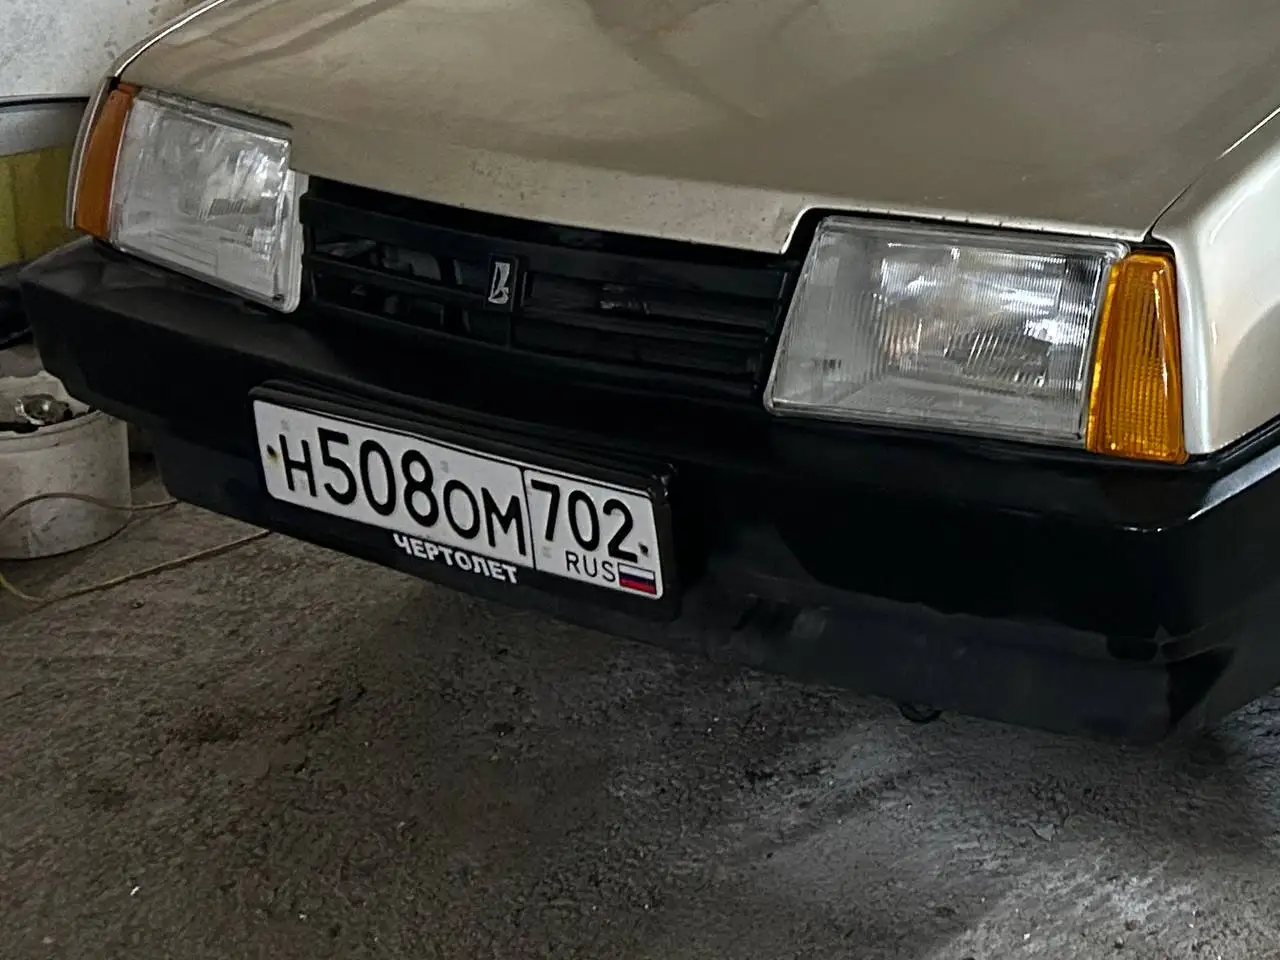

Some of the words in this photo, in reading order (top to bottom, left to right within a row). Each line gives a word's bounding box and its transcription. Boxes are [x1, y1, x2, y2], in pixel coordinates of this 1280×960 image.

[279, 427, 527, 556] Н508ОМ
[531, 479, 638, 562] 702
[394, 533, 518, 584] ЧЕРТОЛЕТ
[565, 550, 616, 583] RUS
